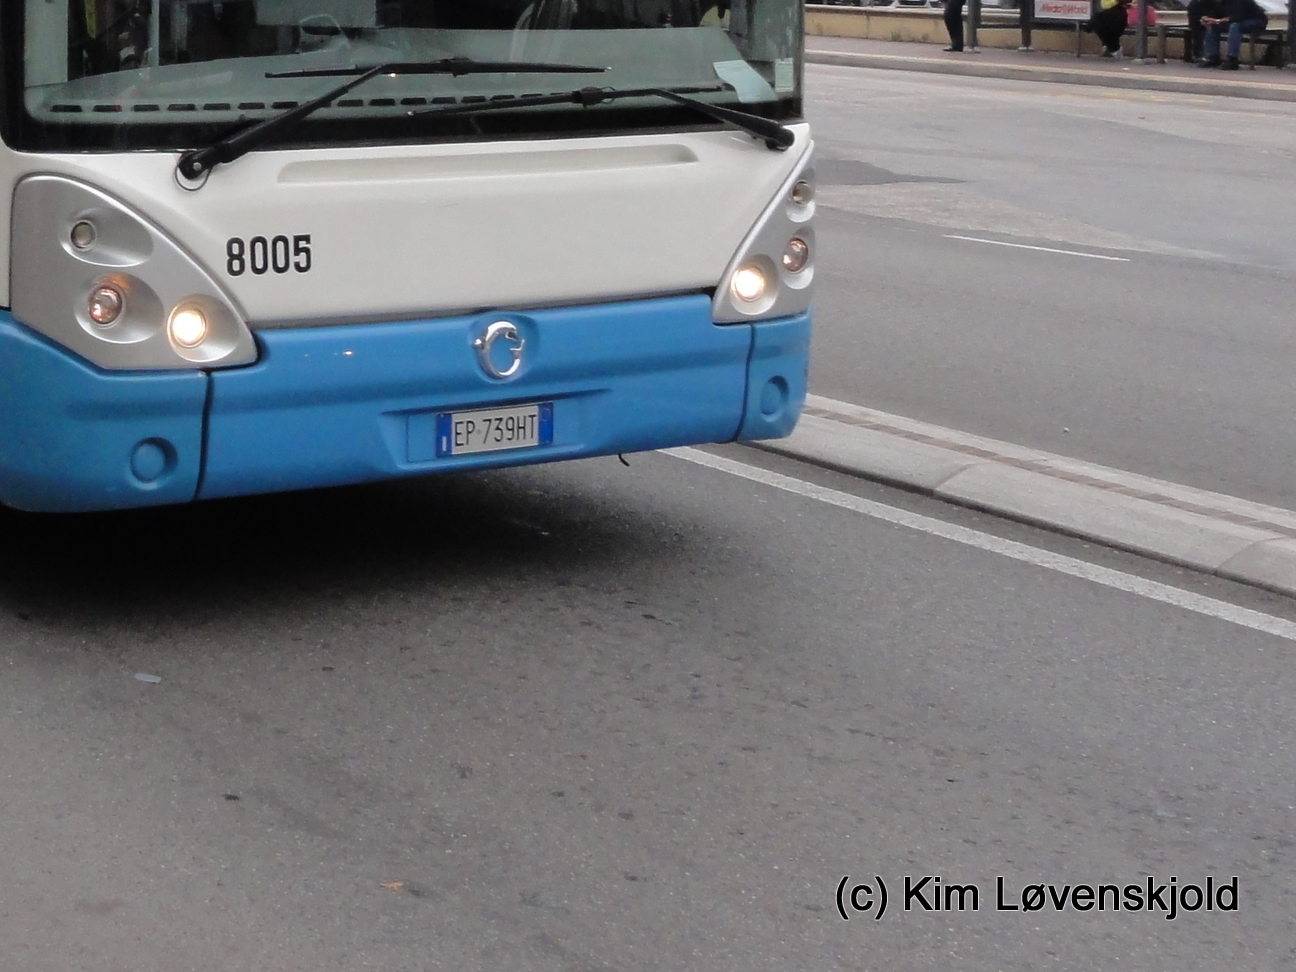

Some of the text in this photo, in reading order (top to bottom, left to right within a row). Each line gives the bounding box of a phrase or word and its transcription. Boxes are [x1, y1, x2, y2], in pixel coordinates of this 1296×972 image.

[226, 234, 312, 277] 8005
[454, 414, 537, 447] EP 739HT
